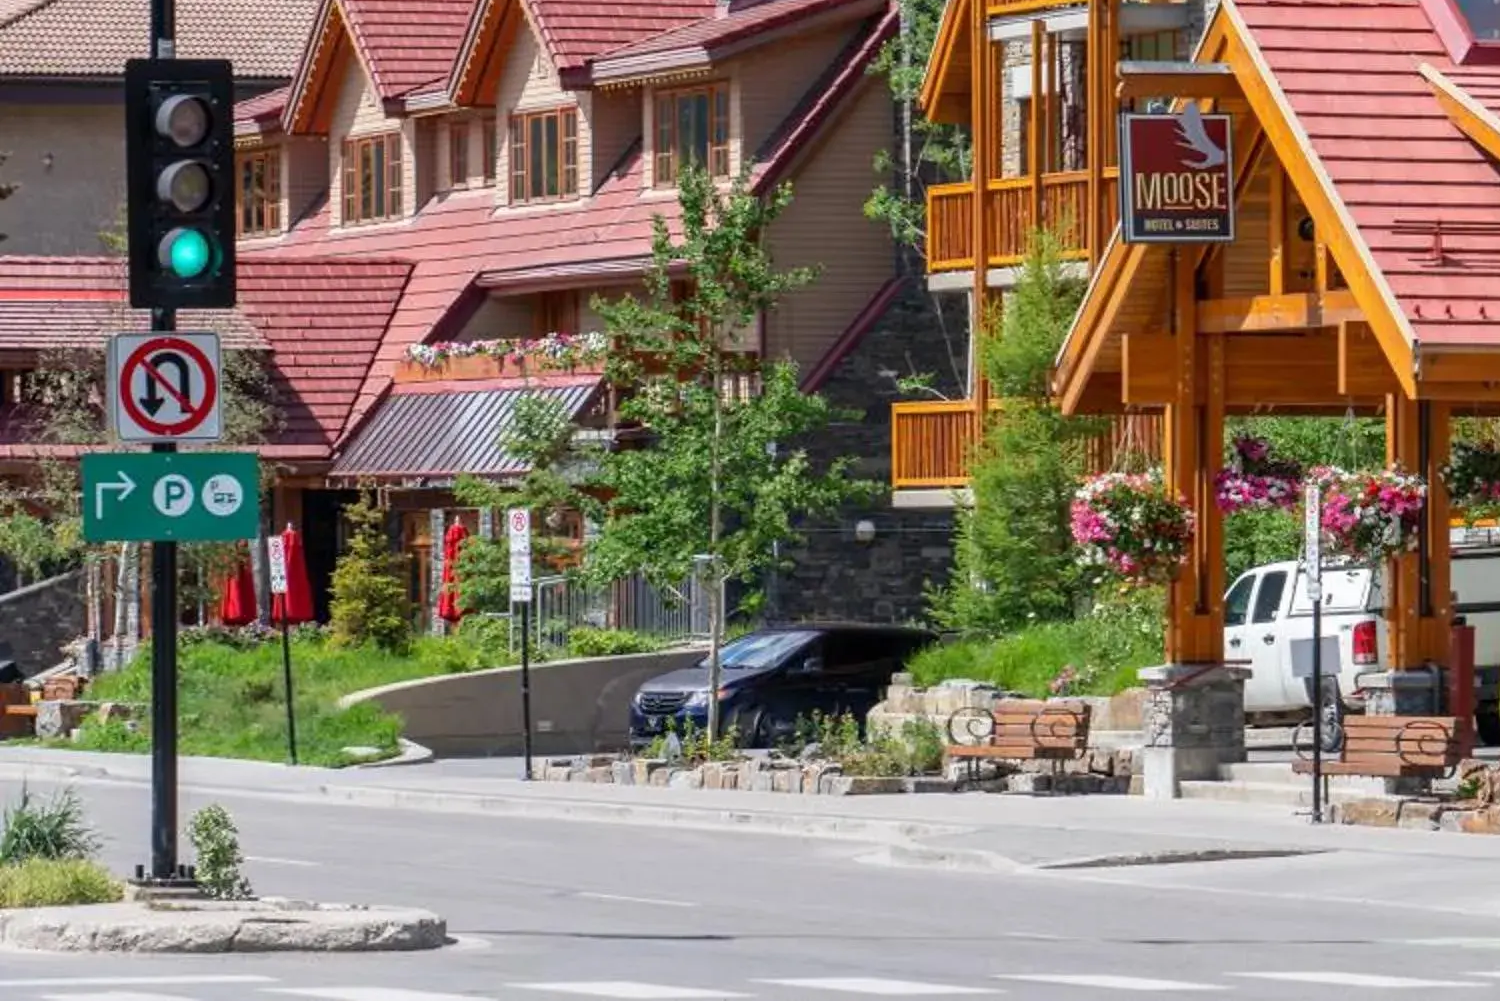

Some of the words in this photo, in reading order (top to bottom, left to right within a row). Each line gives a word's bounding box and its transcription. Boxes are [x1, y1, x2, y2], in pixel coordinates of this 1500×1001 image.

[1135, 172, 1227, 210] MOOSE
[1144, 218, 1174, 231] HOTEL
[1185, 218, 1219, 231] SUITES
[165, 480, 186, 510] P
